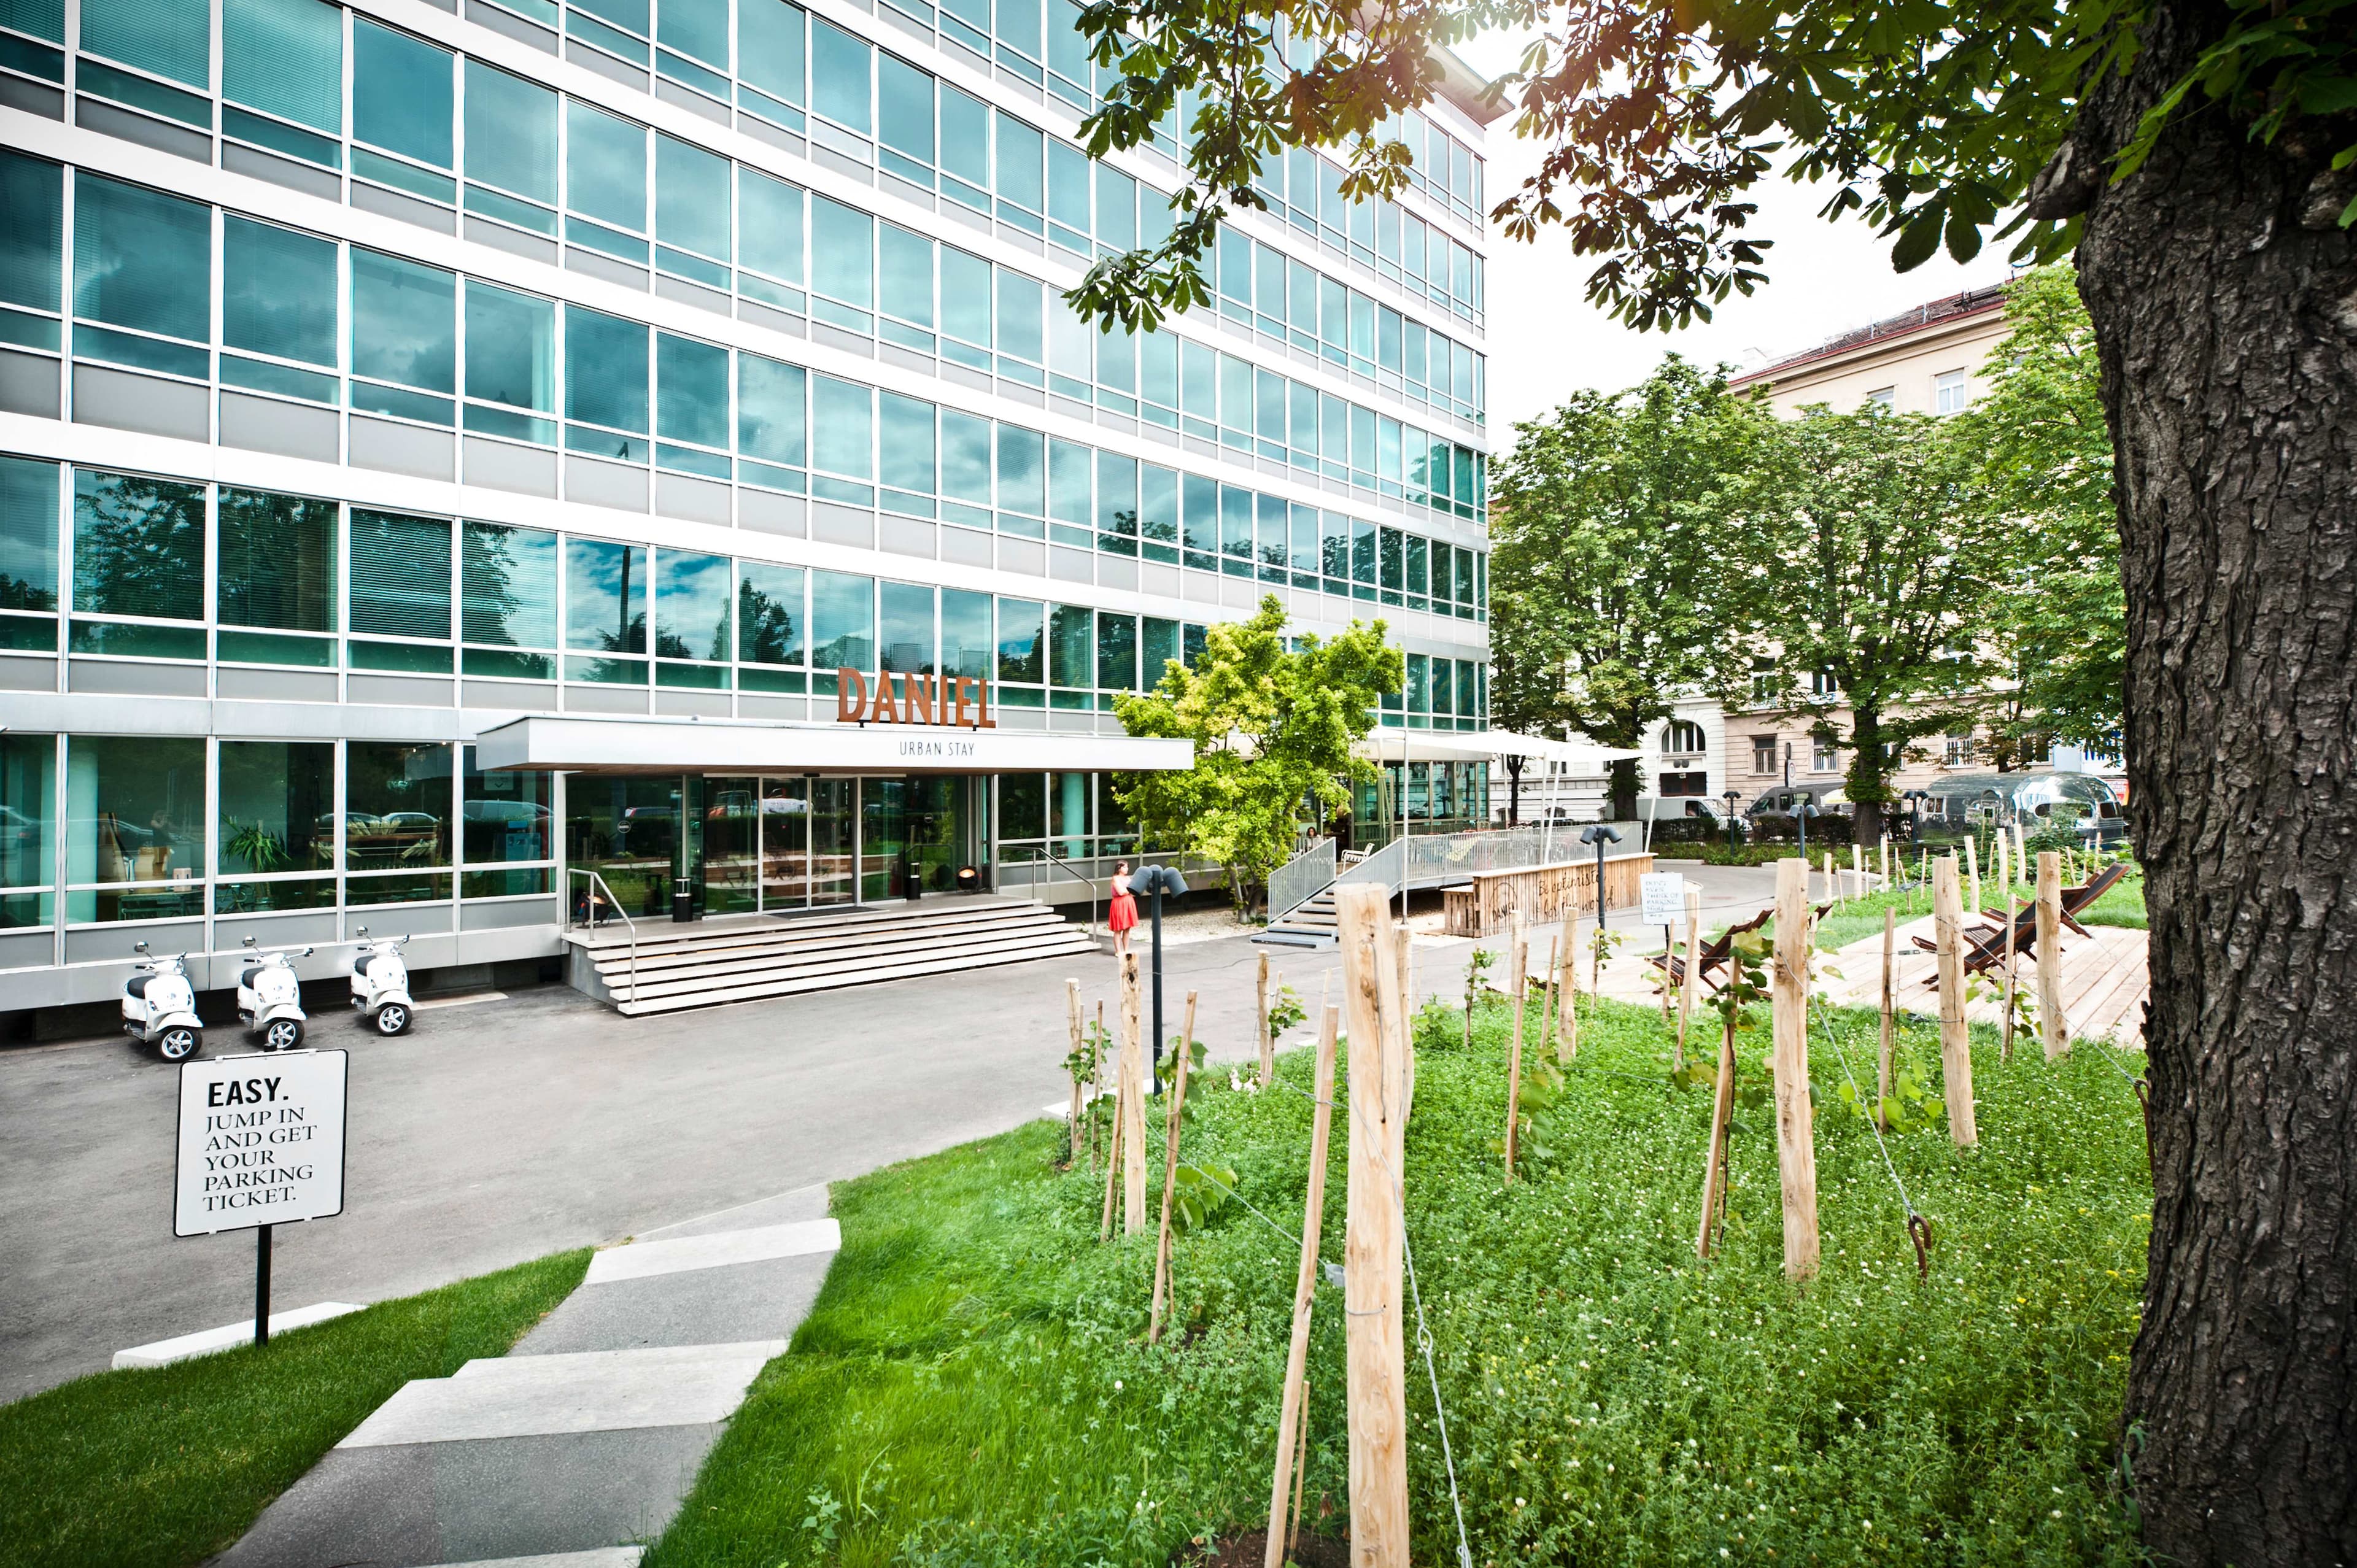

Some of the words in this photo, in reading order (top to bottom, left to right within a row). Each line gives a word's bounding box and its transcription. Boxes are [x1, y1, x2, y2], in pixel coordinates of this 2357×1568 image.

[838, 667, 996, 728] DANIEL
[899, 741, 942, 756] URBAN
[948, 742, 975, 757] STAY
[1582, 886, 1614, 912] wod
[207, 1076, 289, 1107] EASY.
[206, 1111, 271, 1134] JUMP
[278, 1107, 306, 1124] IN
[206, 1132, 261, 1151] AND
[269, 1125, 317, 1144] GET
[205, 1150, 275, 1171] YOUR
[203, 1165, 312, 1192] PARKING
[203, 1186, 296, 1211] TICKET.
